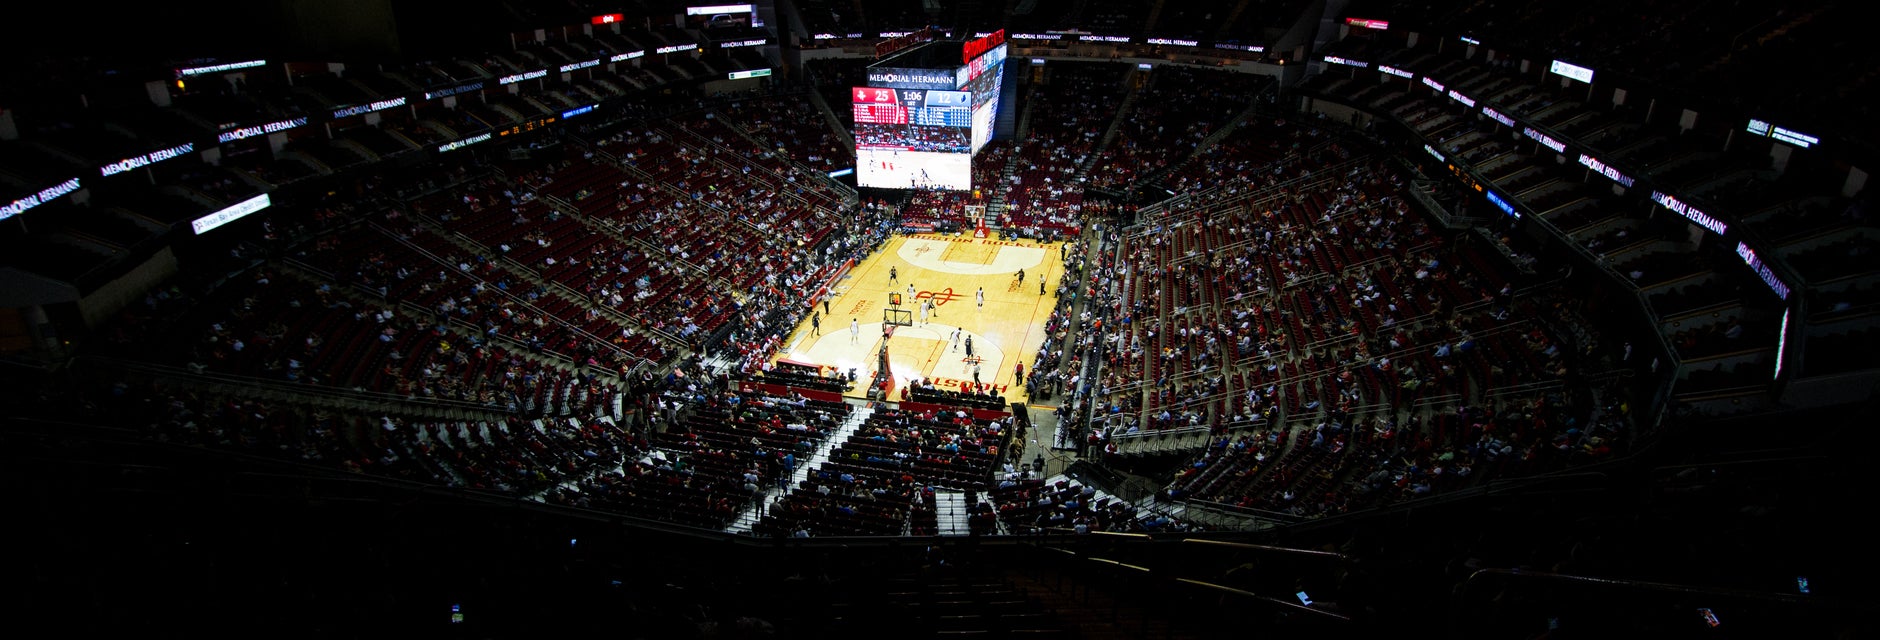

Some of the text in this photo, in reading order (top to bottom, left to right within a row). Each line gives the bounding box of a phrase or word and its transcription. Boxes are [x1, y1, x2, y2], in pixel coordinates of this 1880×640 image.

[743, 38, 767, 47] HERMANN
[1036, 34, 1062, 42] HERMANN
[1104, 35, 1131, 43] HERMANN
[1172, 39, 1198, 47] HERMANN
[656, 43, 698, 54] MEMORIAL HERMANN
[1240, 45, 1264, 53] HERMANN
[610, 50, 645, 62] MEMORIAL HERMANN
[1323, 55, 1369, 68] MEMORIAL HERMANN
[559, 58, 600, 73] MEMORIAL HERMANN
[1377, 65, 1414, 79] MEMORIAL HERMANN
[499, 69, 548, 85] MEMORIAL HERMANN
[869, 73, 953, 84] MEMORIAL HERMANN
[875, 90, 889, 101] 25
[903, 91, 922, 101] 1:06
[937, 92, 951, 104] 12
[333, 96, 406, 119] MEMORIAL HERMANN
[1482, 106, 1516, 128] MEMORIAL HERMANN
[218, 117, 307, 143] MEMORIAL HERMANN
[438, 132, 492, 153] MEMORIAL HERMANN
[1523, 127, 1566, 153] MEMORIAL HERMANN
[100, 142, 193, 177] MEMORIAL HERMANN
[1578, 153, 1635, 187] MEMORIAL HERMANN
[38, 178, 80, 203] HERMANN
[1652, 190, 1727, 236] MEMORIAL HERMANN
[899, 234, 974, 243] HOUSTON
[982, 239, 1058, 250] ROCKETS
[1735, 241, 1790, 301] MEMORIAL HERMANN
